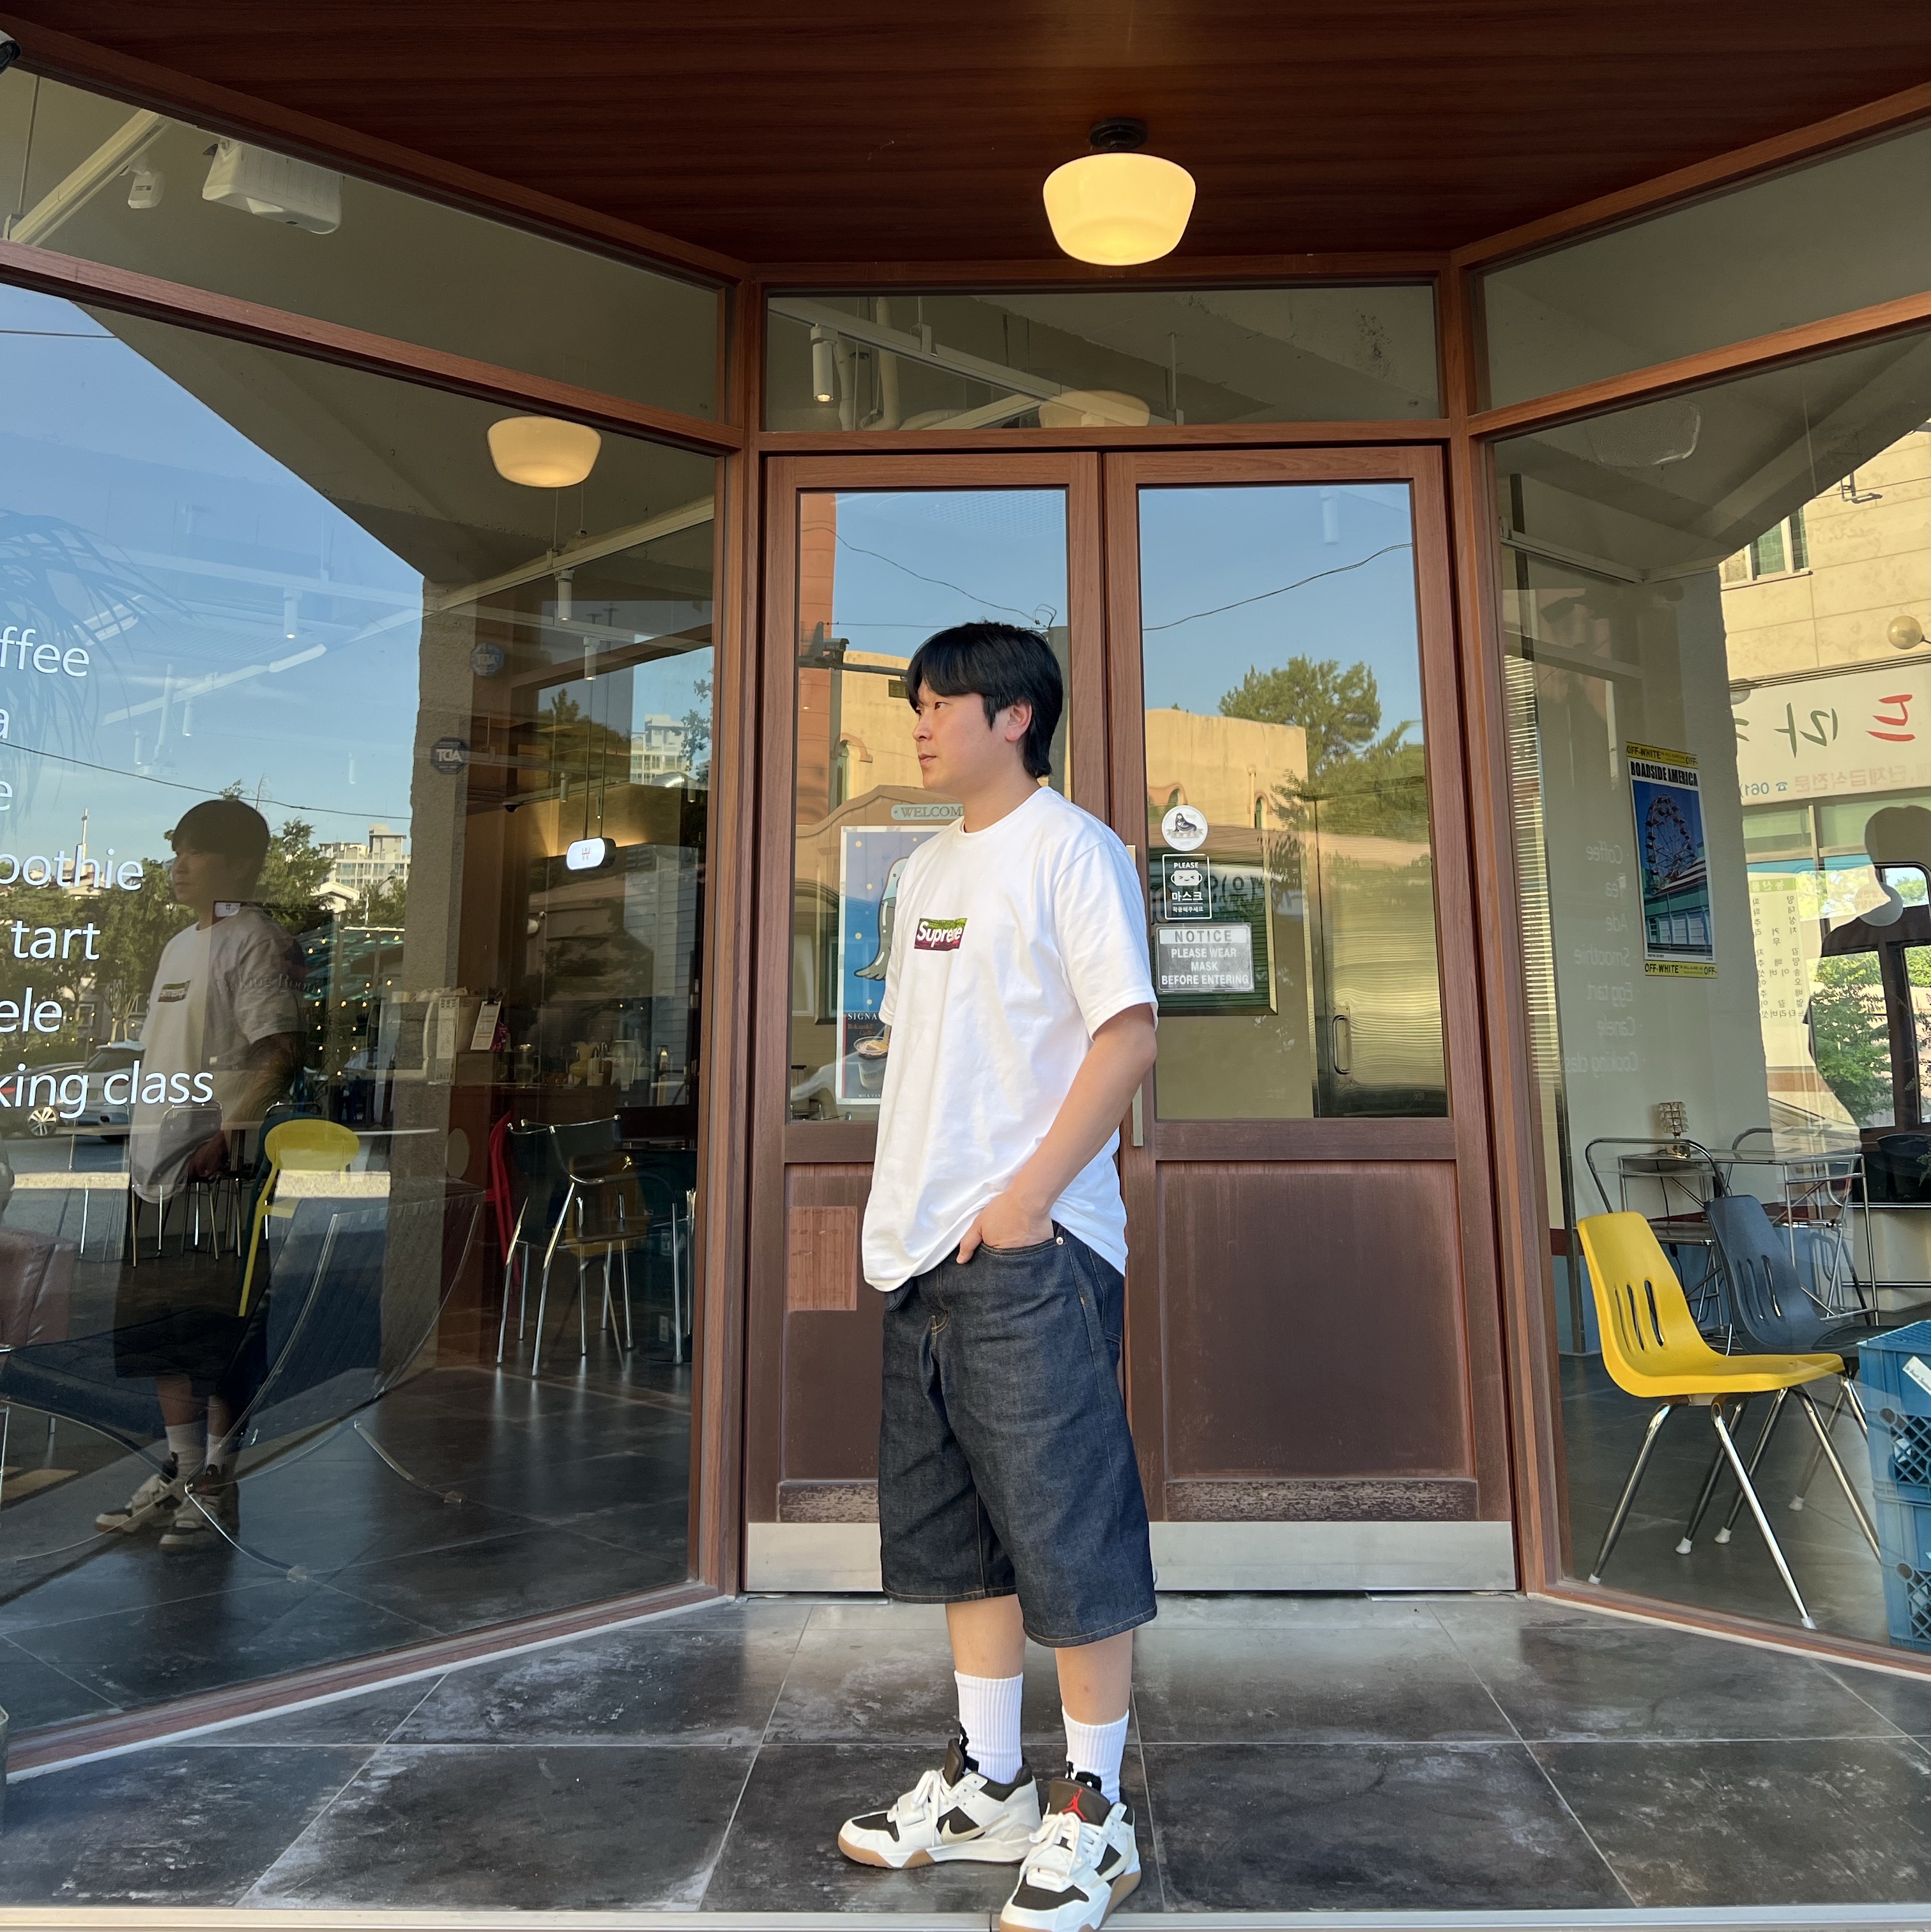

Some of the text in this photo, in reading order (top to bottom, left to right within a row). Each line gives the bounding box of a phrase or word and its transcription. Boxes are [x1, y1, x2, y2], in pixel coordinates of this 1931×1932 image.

[1626, 745, 1661, 760] OFF-WHITE
[1630, 760, 1698, 787] ROADSIDE AMERICA
[1172, 891, 1203, 902] 마스크
[11, 920, 101, 960] tart
[1175, 930, 1232, 942] NOTICE
[1171, 947, 1237, 958] PLEASE WEAR
[1191, 961, 1219, 971] MASK
[1644, 963, 1679, 974] OFF-WHITE
[1161, 974, 1249, 985] BEFORE ENTERING
[847, 1012, 878, 1020] SIGNA
[103, 1060, 214, 1105] class
